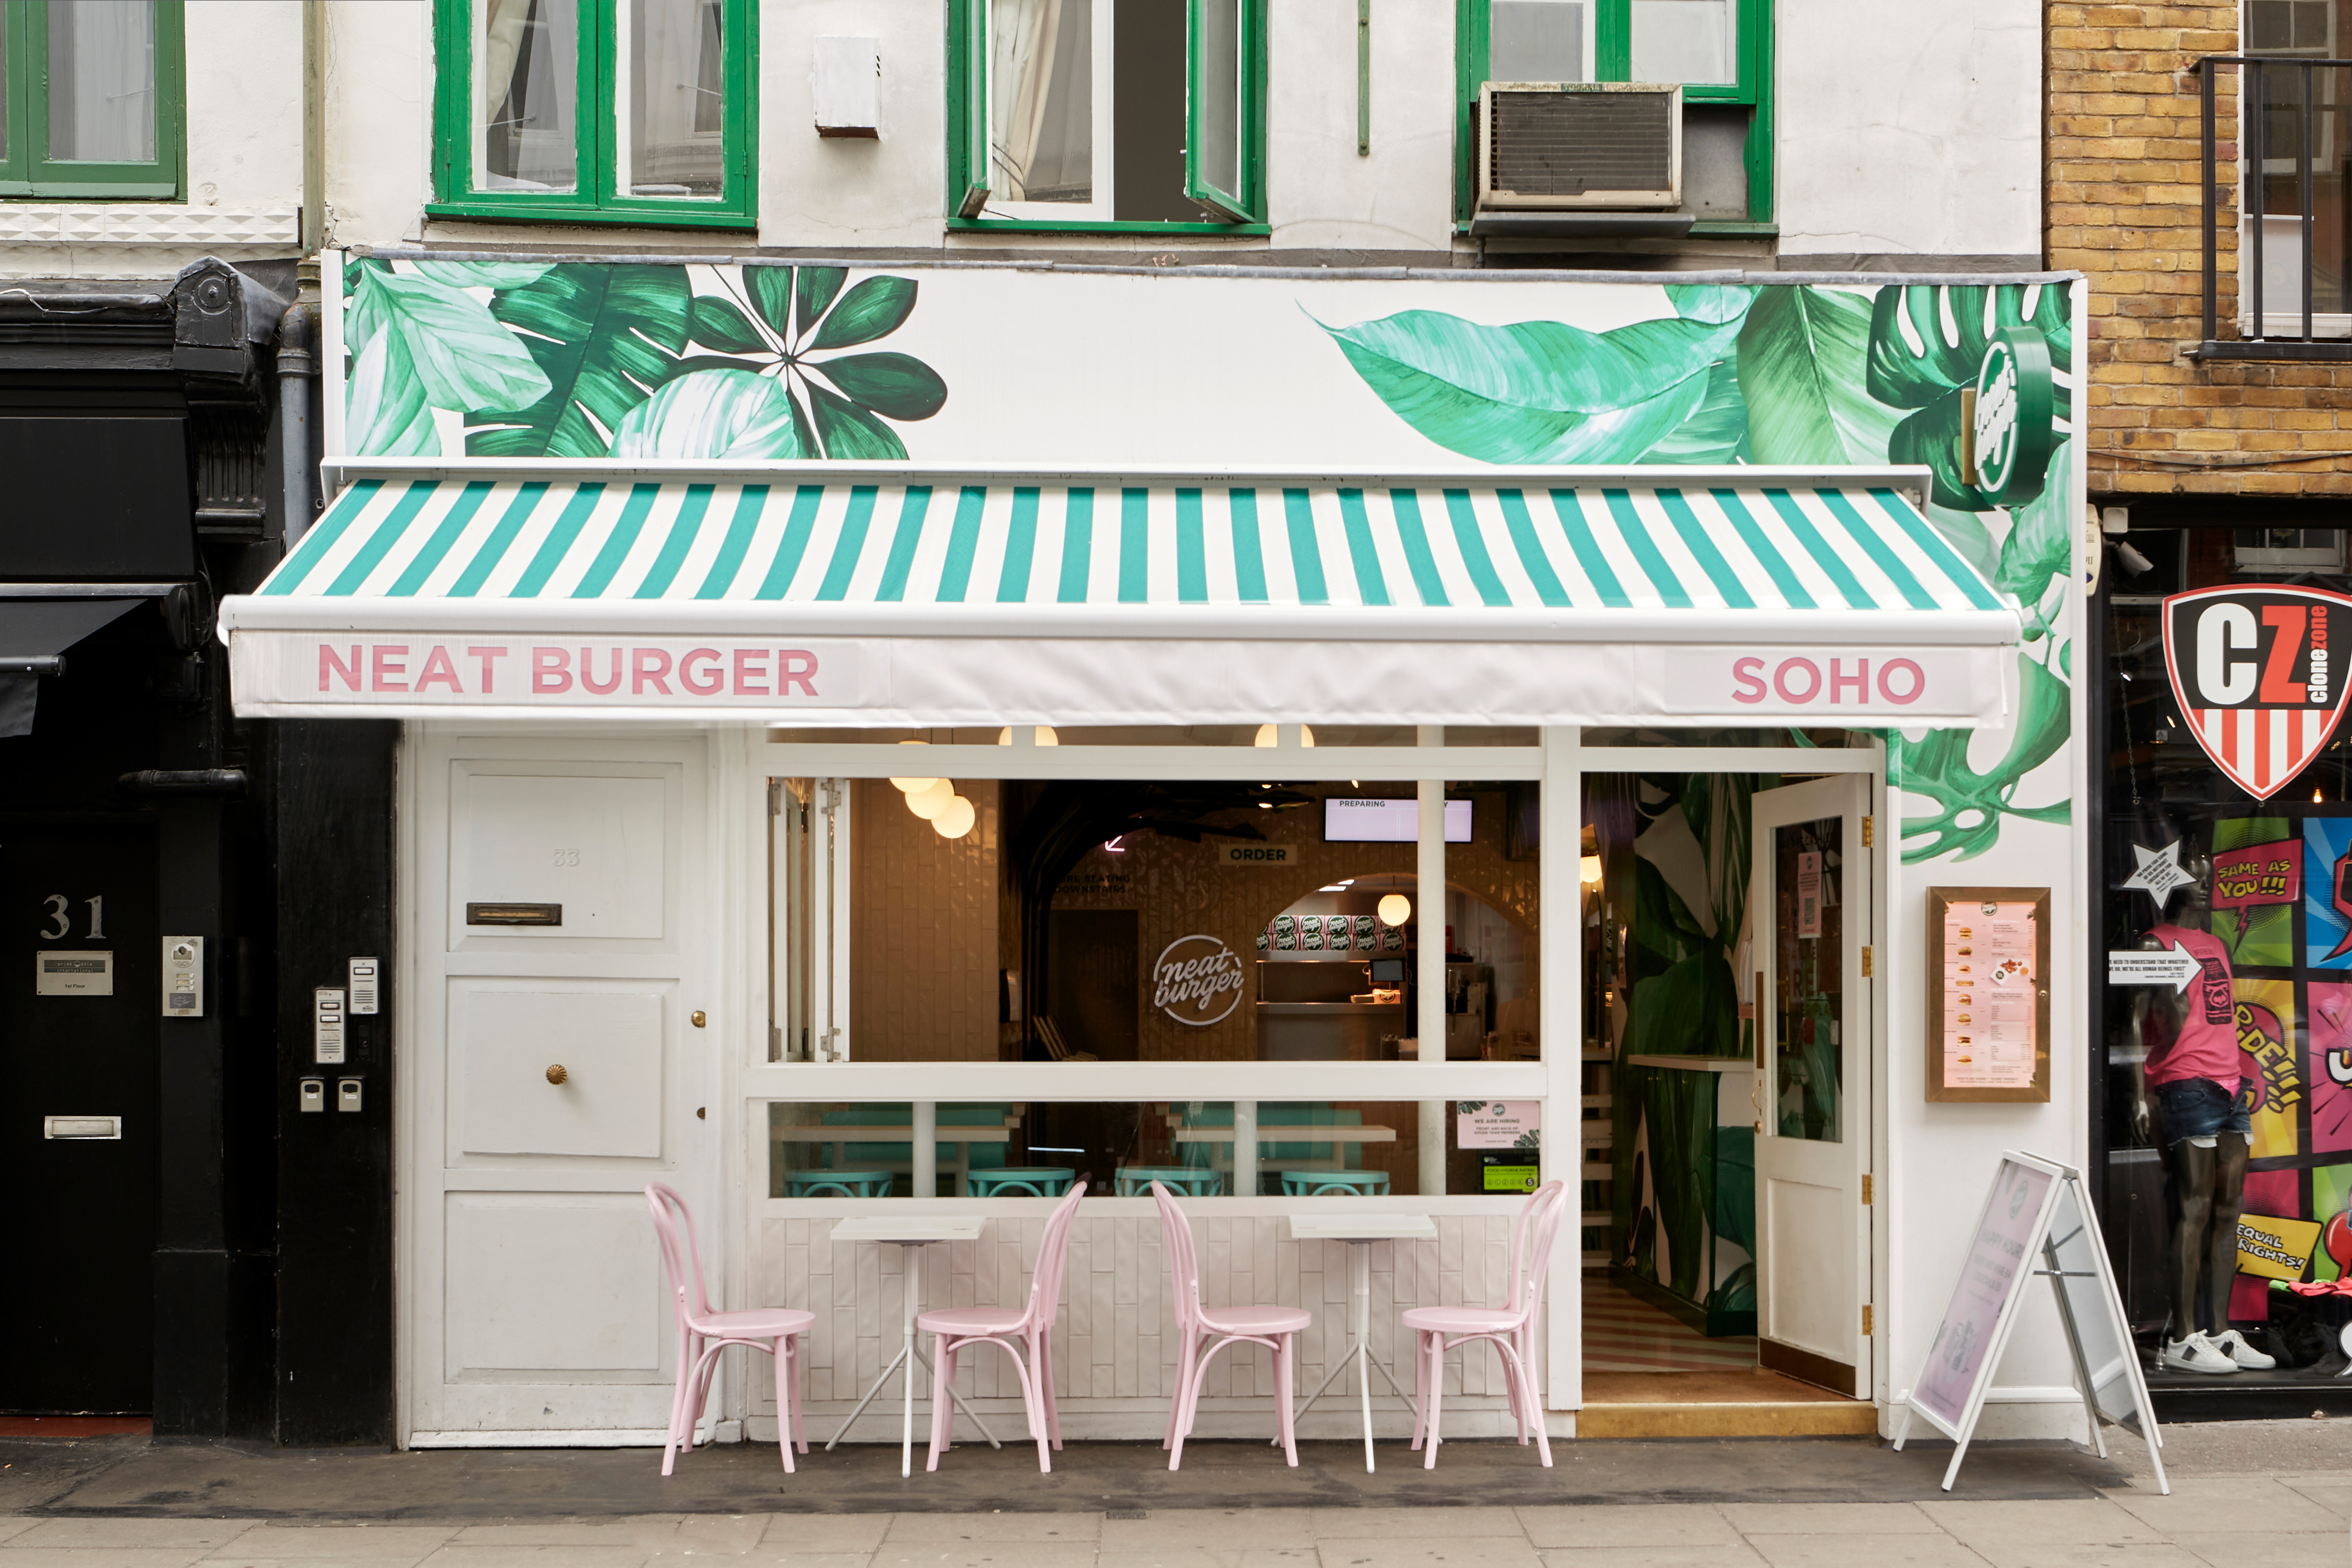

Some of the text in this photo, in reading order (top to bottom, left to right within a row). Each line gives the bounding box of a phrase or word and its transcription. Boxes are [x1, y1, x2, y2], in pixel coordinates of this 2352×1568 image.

[319, 644, 819, 697] NEAT BURGER
[2197, 602, 2307, 705] CZ
[2307, 605, 2328, 704] clonezone
[1731, 656, 1925, 705] SOHO
[552, 848, 580, 867] 33
[1230, 848, 1287, 861] ORDER
[2217, 860, 2291, 879] SAME AS
[1085, 874, 1130, 883] SEATING
[40, 894, 107, 939] 31
[1161, 946, 1234, 985] neat
[1154, 968, 1244, 1010] burger
[1527, 1178, 1533, 1186] 5
[2236, 1224, 2283, 1249] EQUAL
[2237, 1237, 2306, 1270] RIGHTS!
